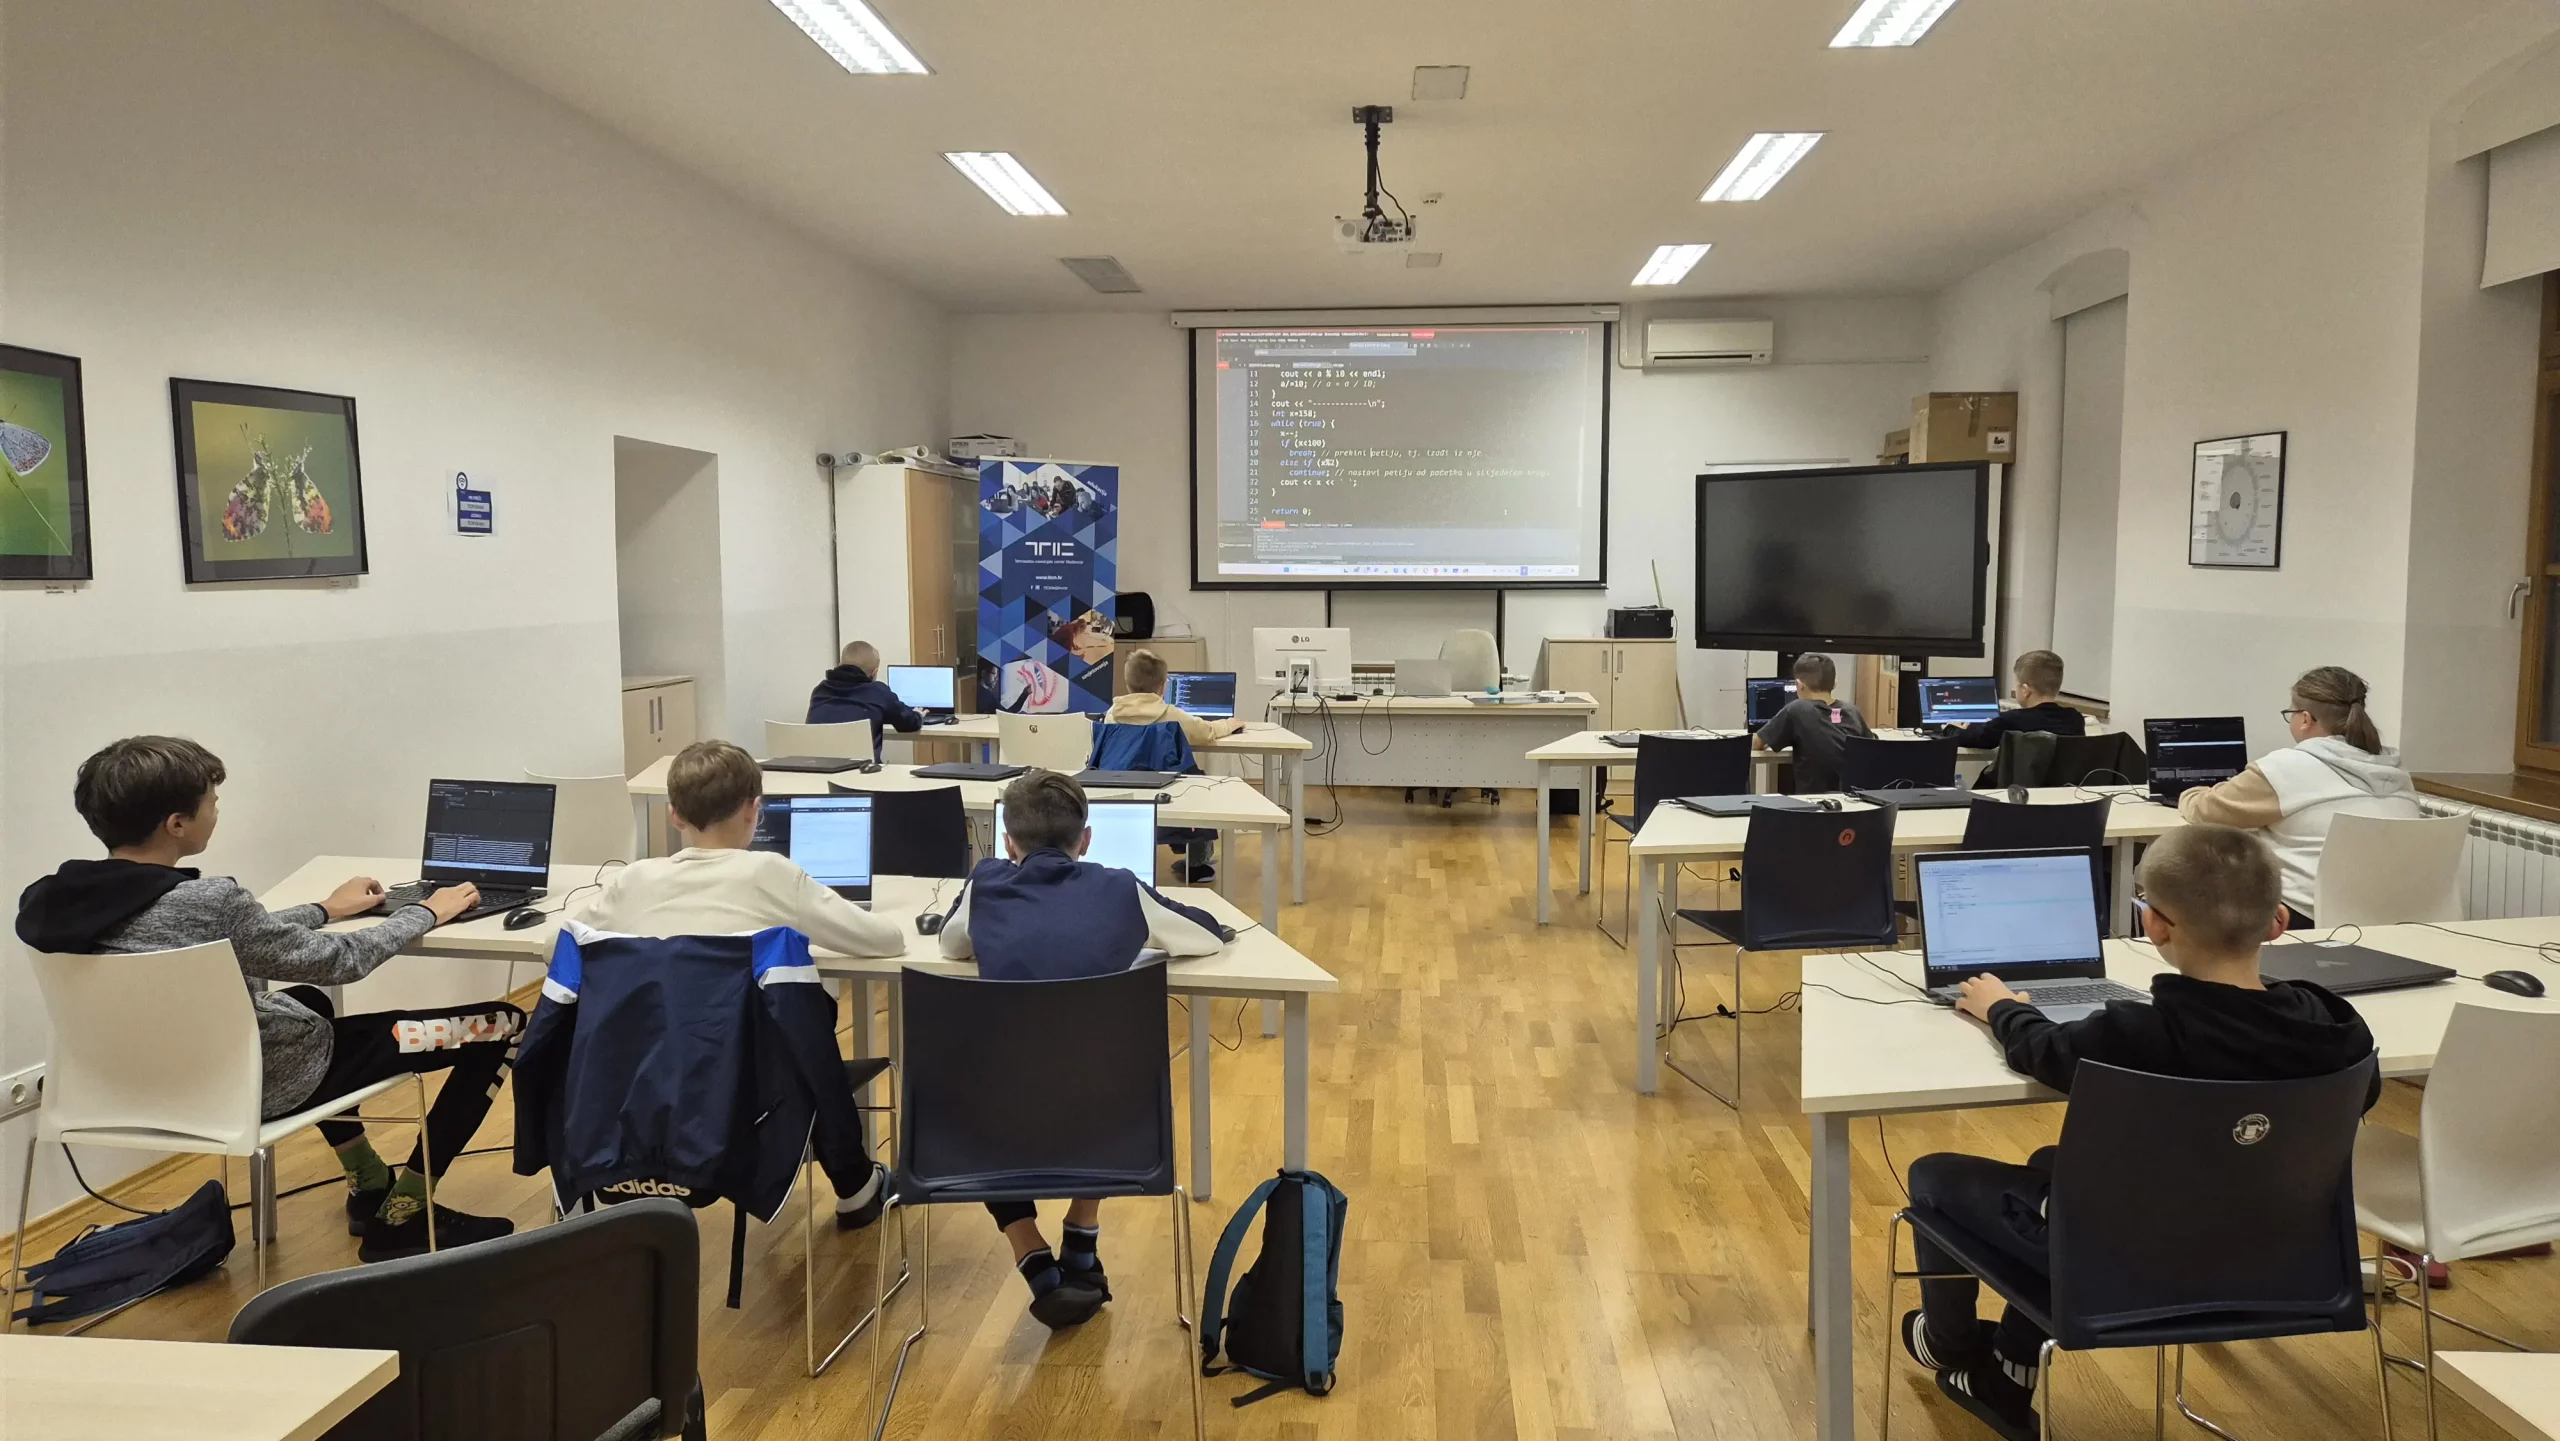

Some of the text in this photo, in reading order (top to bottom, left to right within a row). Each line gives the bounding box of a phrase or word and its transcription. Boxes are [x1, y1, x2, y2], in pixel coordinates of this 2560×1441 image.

[1299, 420, 1326, 428] (true)
[1303, 459, 1312, 467] if
[1289, 469, 1330, 477] continue;
